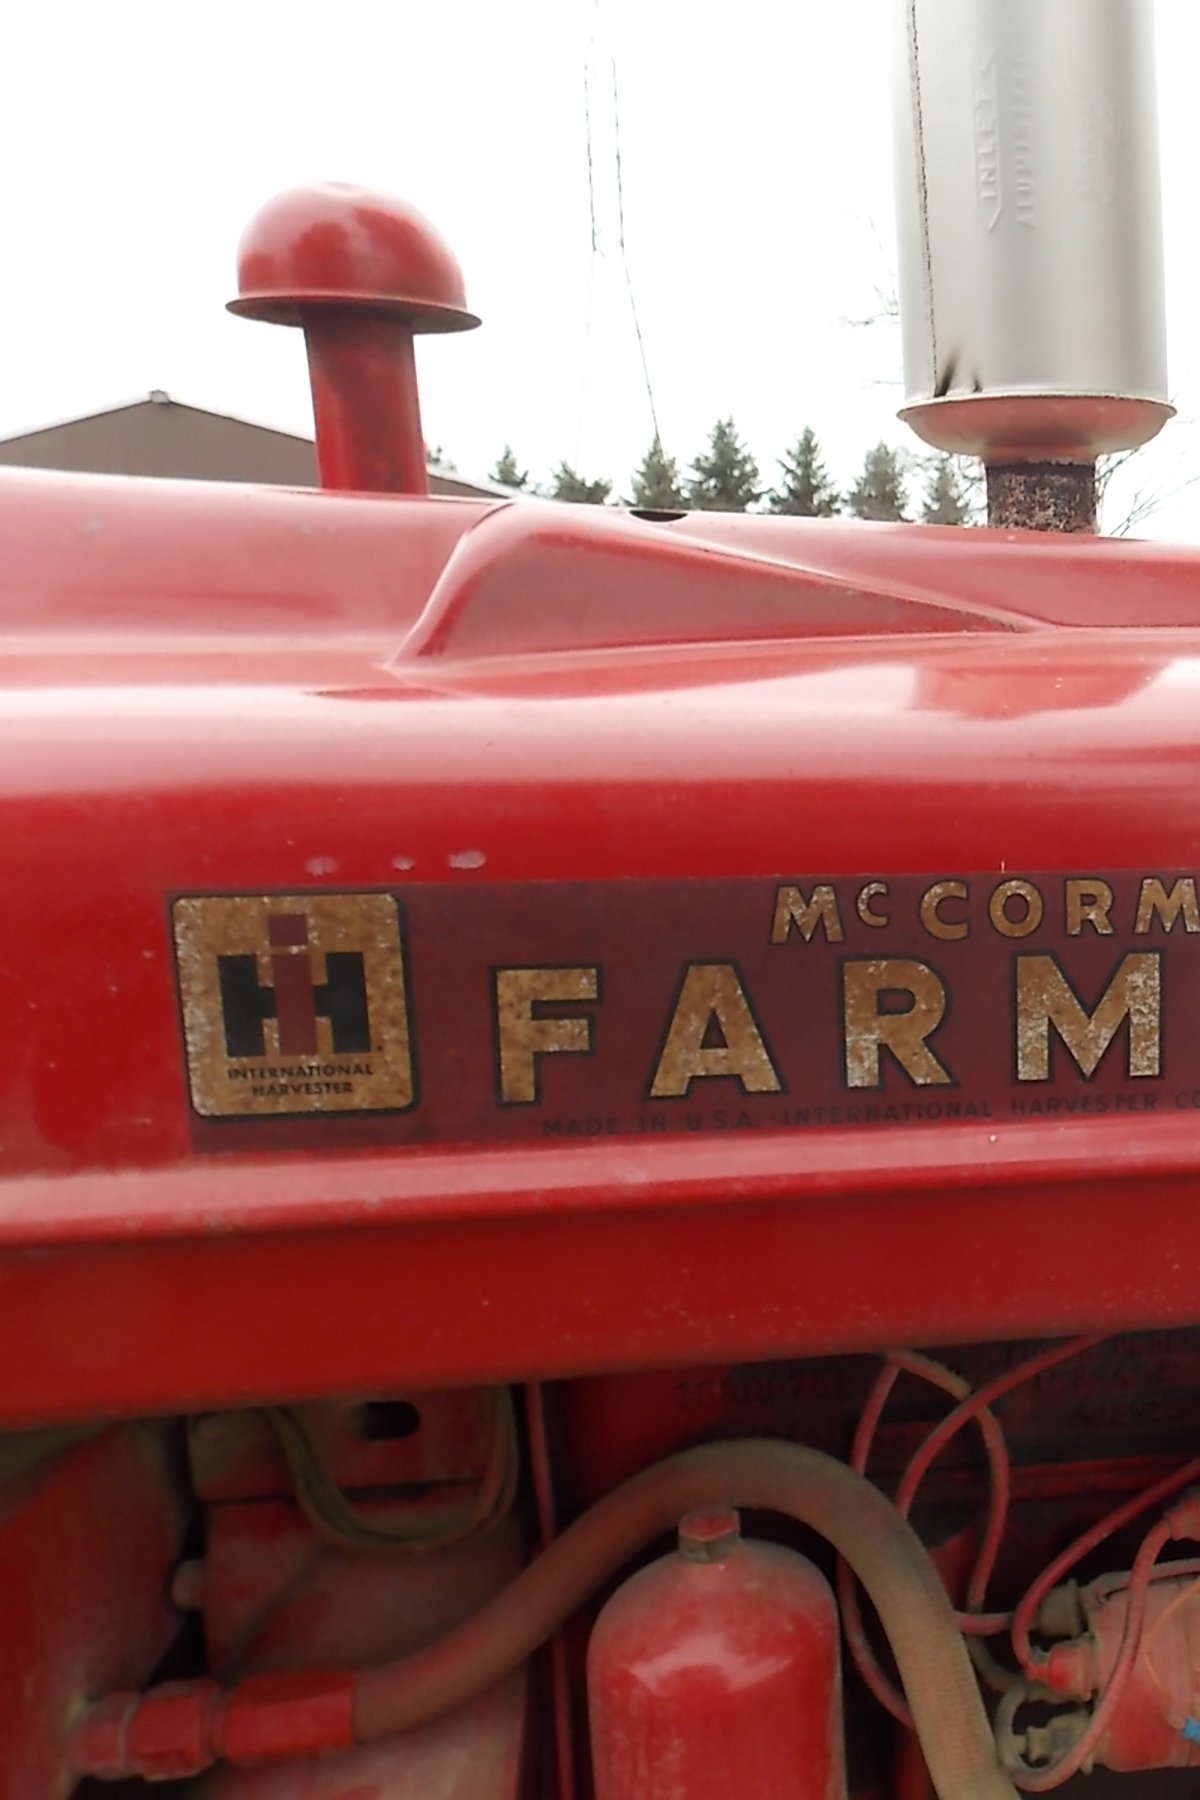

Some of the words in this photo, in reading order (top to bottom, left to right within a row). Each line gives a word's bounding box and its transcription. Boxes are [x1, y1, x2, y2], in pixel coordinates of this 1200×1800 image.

[975, 87, 998, 201] INLET
[228, 1063, 374, 1080] INTERNATIONAL
[252, 1081, 355, 1097] HARVESTER
[542, 1118, 620, 1137] MADE
[639, 1116, 667, 1133] IN
[783, 1101, 993, 1127] INTERNATIONAL
[1010, 1093, 1159, 1117] HARVESTER
